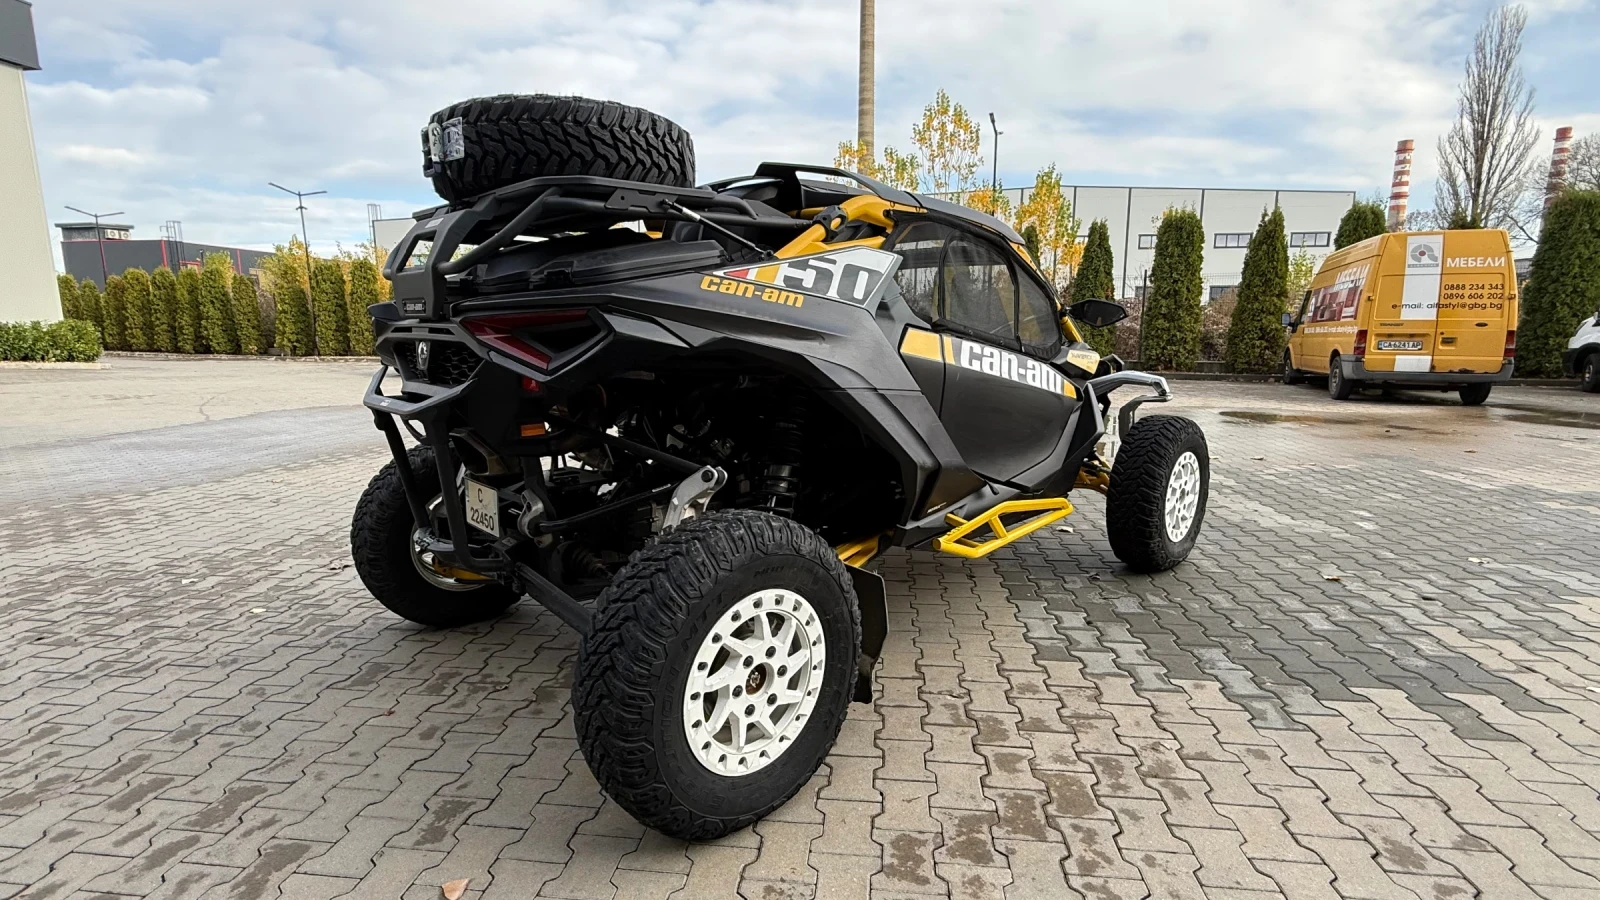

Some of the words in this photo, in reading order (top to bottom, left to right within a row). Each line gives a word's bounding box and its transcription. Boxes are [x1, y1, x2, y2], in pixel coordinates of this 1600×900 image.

[1446, 256, 1505, 268] МЕБЕЛИ
[1444, 283, 1466, 291] 0888
[1468, 283, 1485, 291] 234
[1488, 283, 1505, 291] 343
[1443, 292, 1465, 300] 0896
[1467, 292, 1484, 300] 606
[1487, 292, 1504, 300] 202
[477, 487, 484, 504] C
[470, 506, 495, 531] 22450
